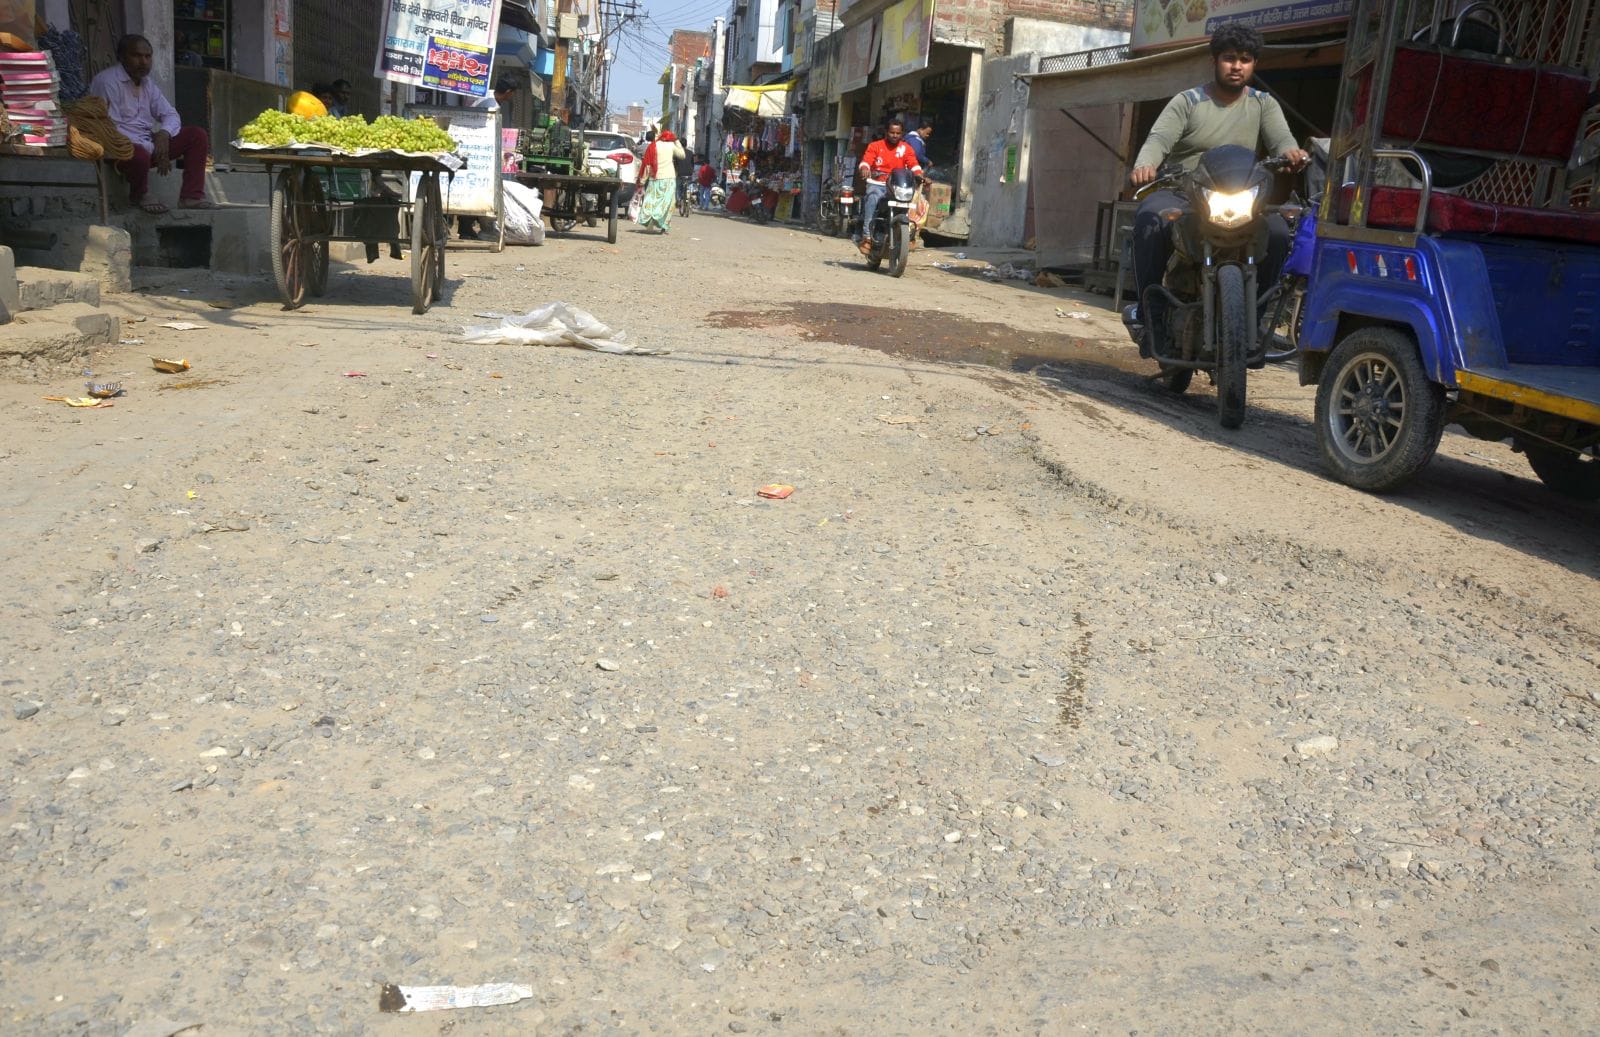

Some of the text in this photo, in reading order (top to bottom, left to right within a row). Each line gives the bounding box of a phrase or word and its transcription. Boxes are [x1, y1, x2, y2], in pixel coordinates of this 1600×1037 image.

[408, 2, 421, 16] देवी
[450, 11, 466, 27] विद्या
[466, 16, 489, 32] मन्दिर
